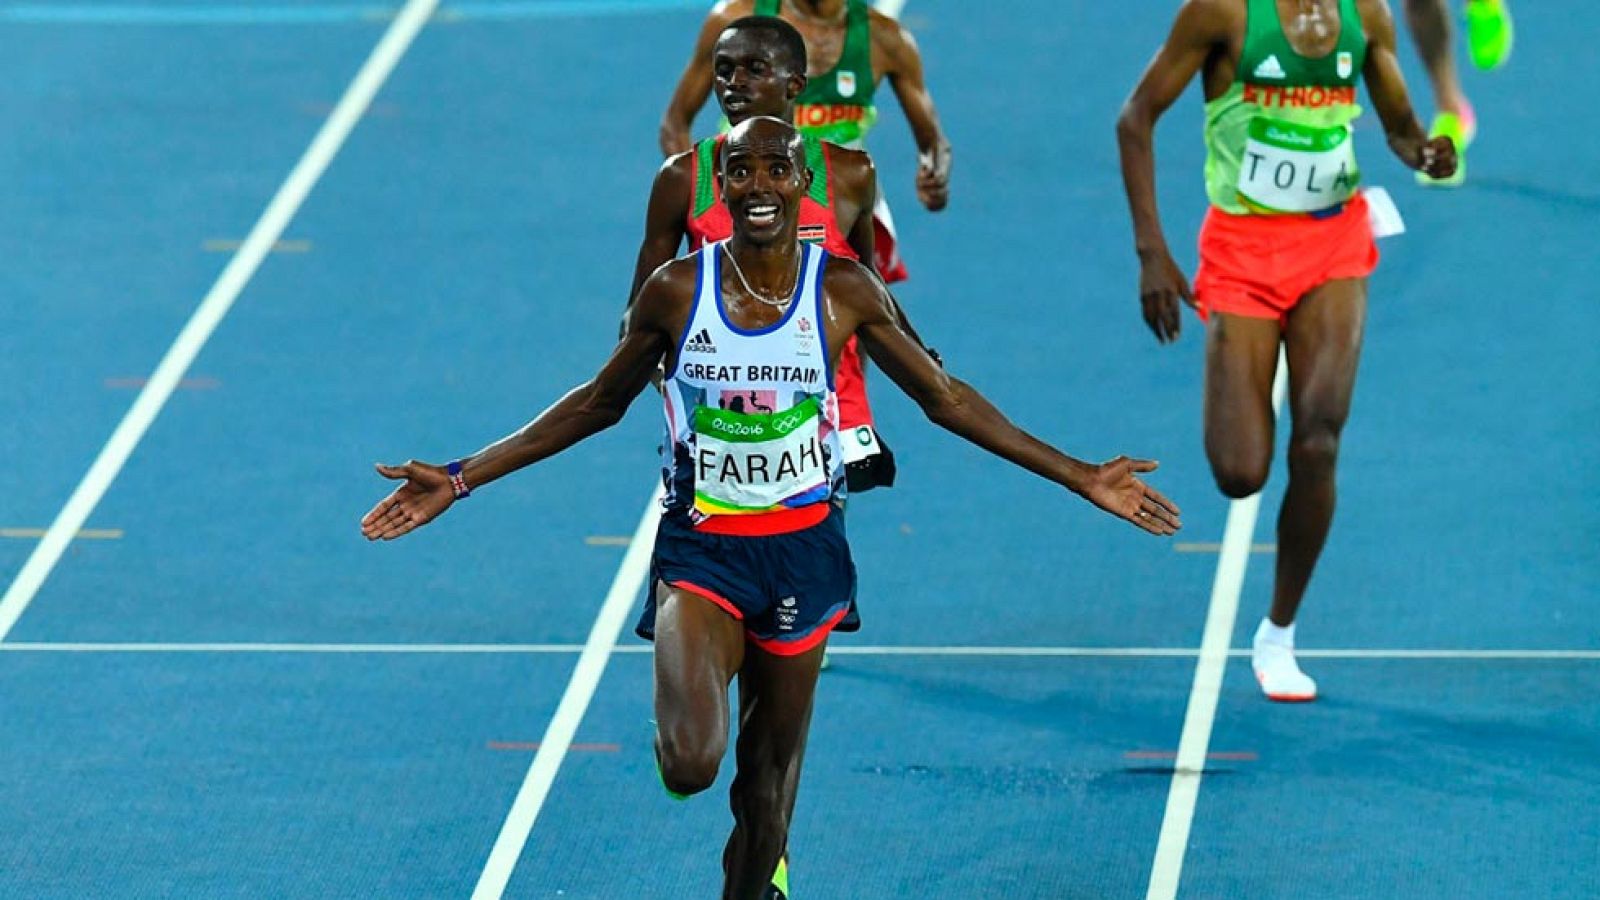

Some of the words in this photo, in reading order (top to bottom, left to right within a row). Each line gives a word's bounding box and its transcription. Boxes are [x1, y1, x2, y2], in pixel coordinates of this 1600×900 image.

[1248, 151, 1350, 193] TOLA
[685, 344, 717, 353] adidas
[683, 362, 742, 382] GREAT
[747, 365, 821, 384] BRITAIN
[700, 436, 819, 484] FARAH
